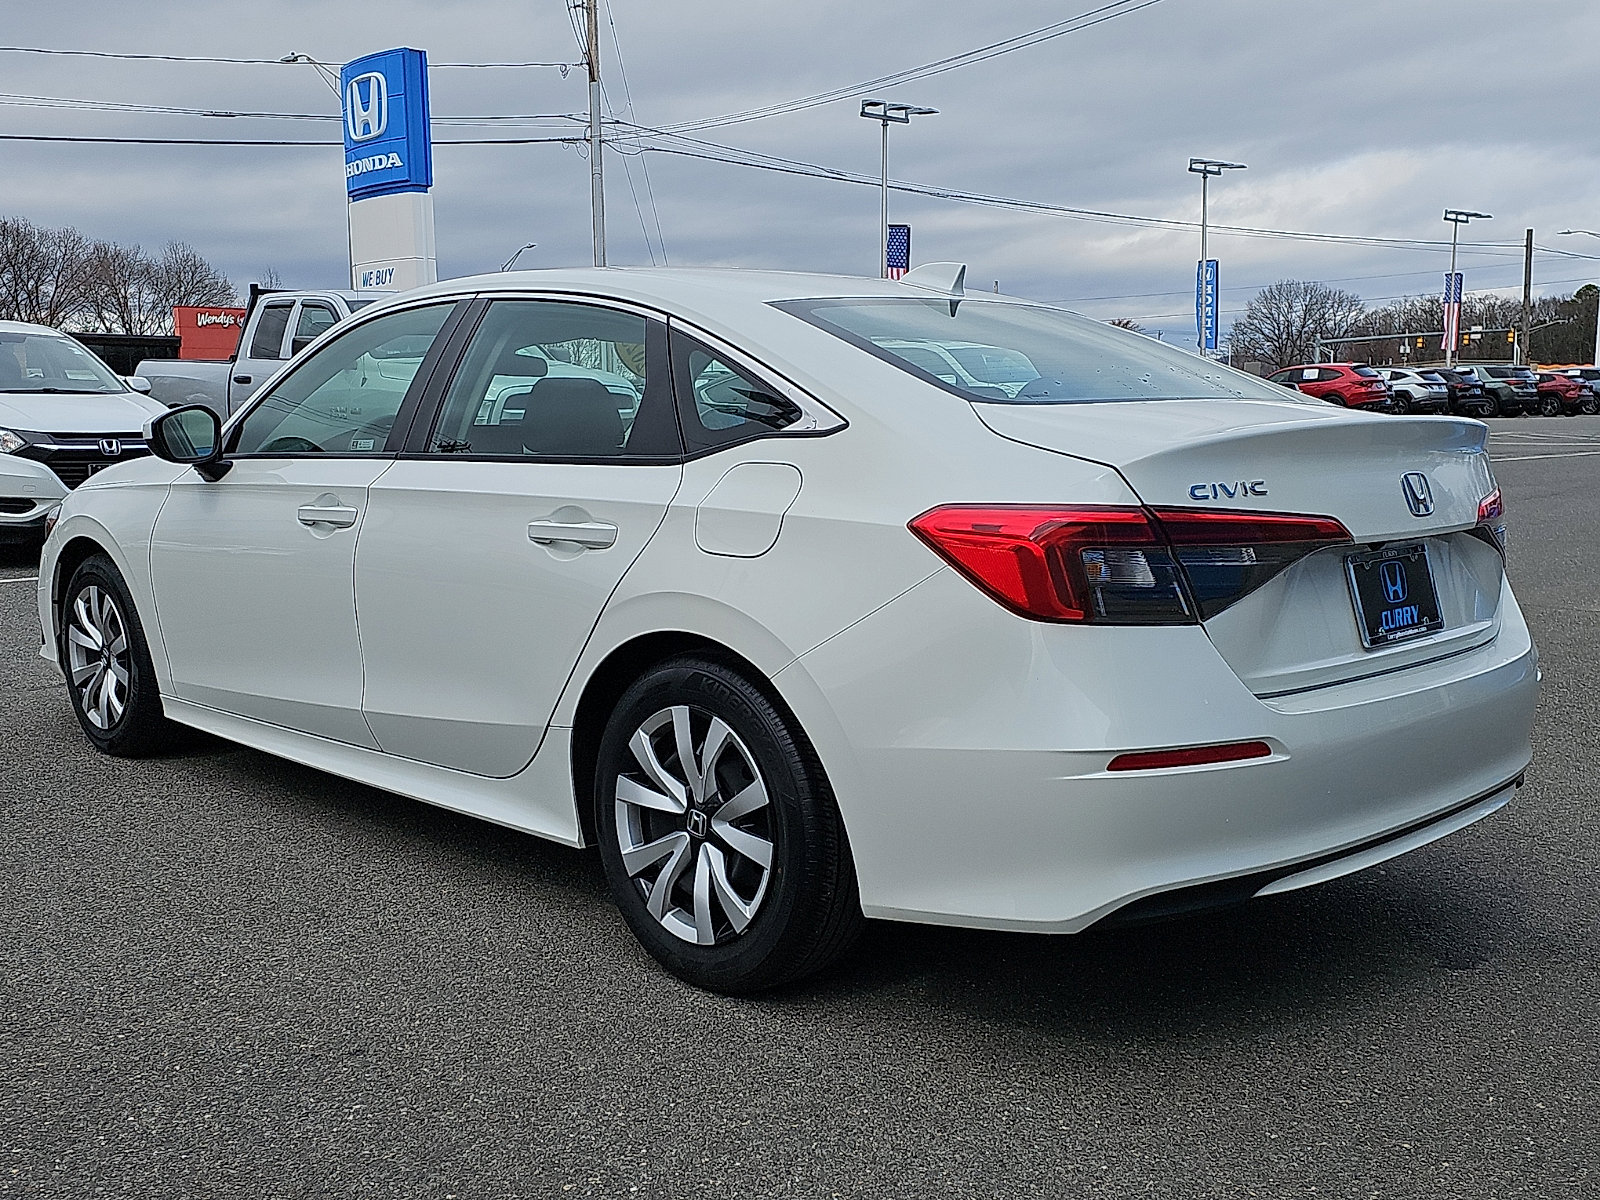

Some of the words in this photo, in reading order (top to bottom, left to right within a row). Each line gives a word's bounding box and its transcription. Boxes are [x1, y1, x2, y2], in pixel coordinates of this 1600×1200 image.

[345, 152, 404, 178] HONDA
[362, 271, 374, 288] WE
[375, 267, 395, 286] BUY
[197, 311, 235, 328] Wendy's
[1188, 480, 1269, 500] CIVIC
[1381, 604, 1420, 630] CURRY
